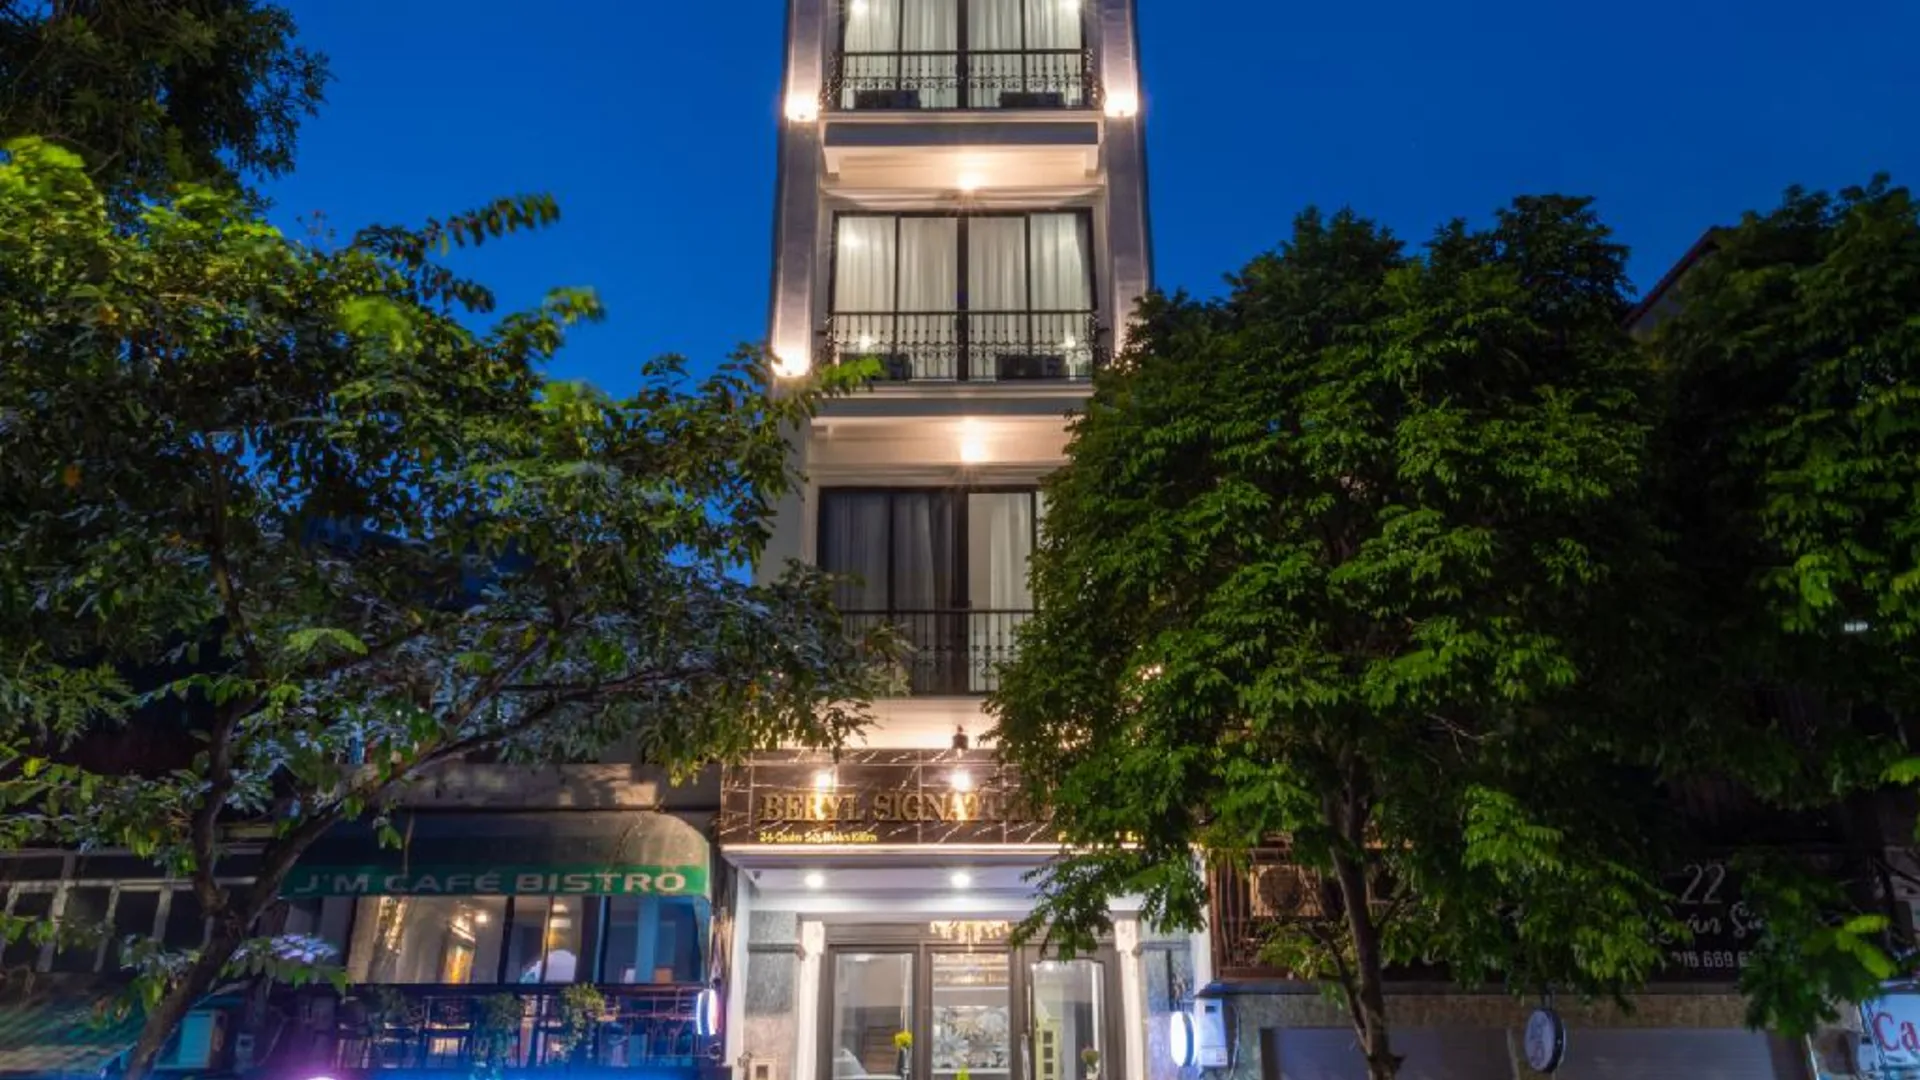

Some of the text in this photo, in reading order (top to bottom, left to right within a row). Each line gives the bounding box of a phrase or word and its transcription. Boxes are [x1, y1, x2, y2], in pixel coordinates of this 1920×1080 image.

[759, 793, 865, 821] BERYL
[293, 869, 687, 893] J'M CAFÉ BISTRO
[1679, 863, 1726, 904] 22
